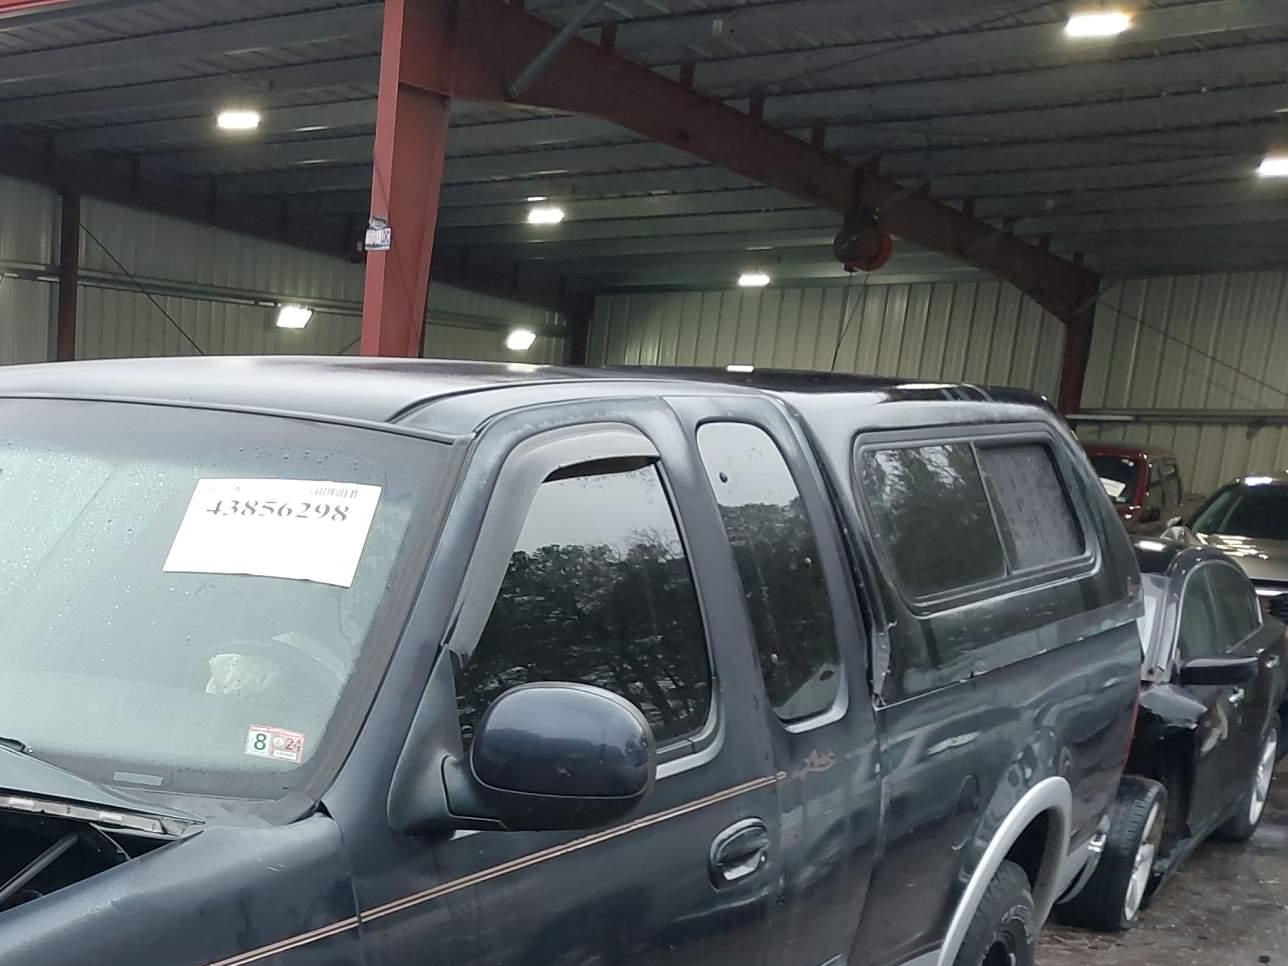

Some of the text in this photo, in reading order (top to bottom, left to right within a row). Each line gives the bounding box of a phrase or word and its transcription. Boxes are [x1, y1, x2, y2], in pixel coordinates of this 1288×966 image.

[206, 499, 350, 523] 43856298
[253, 732, 302, 753] 8 24
